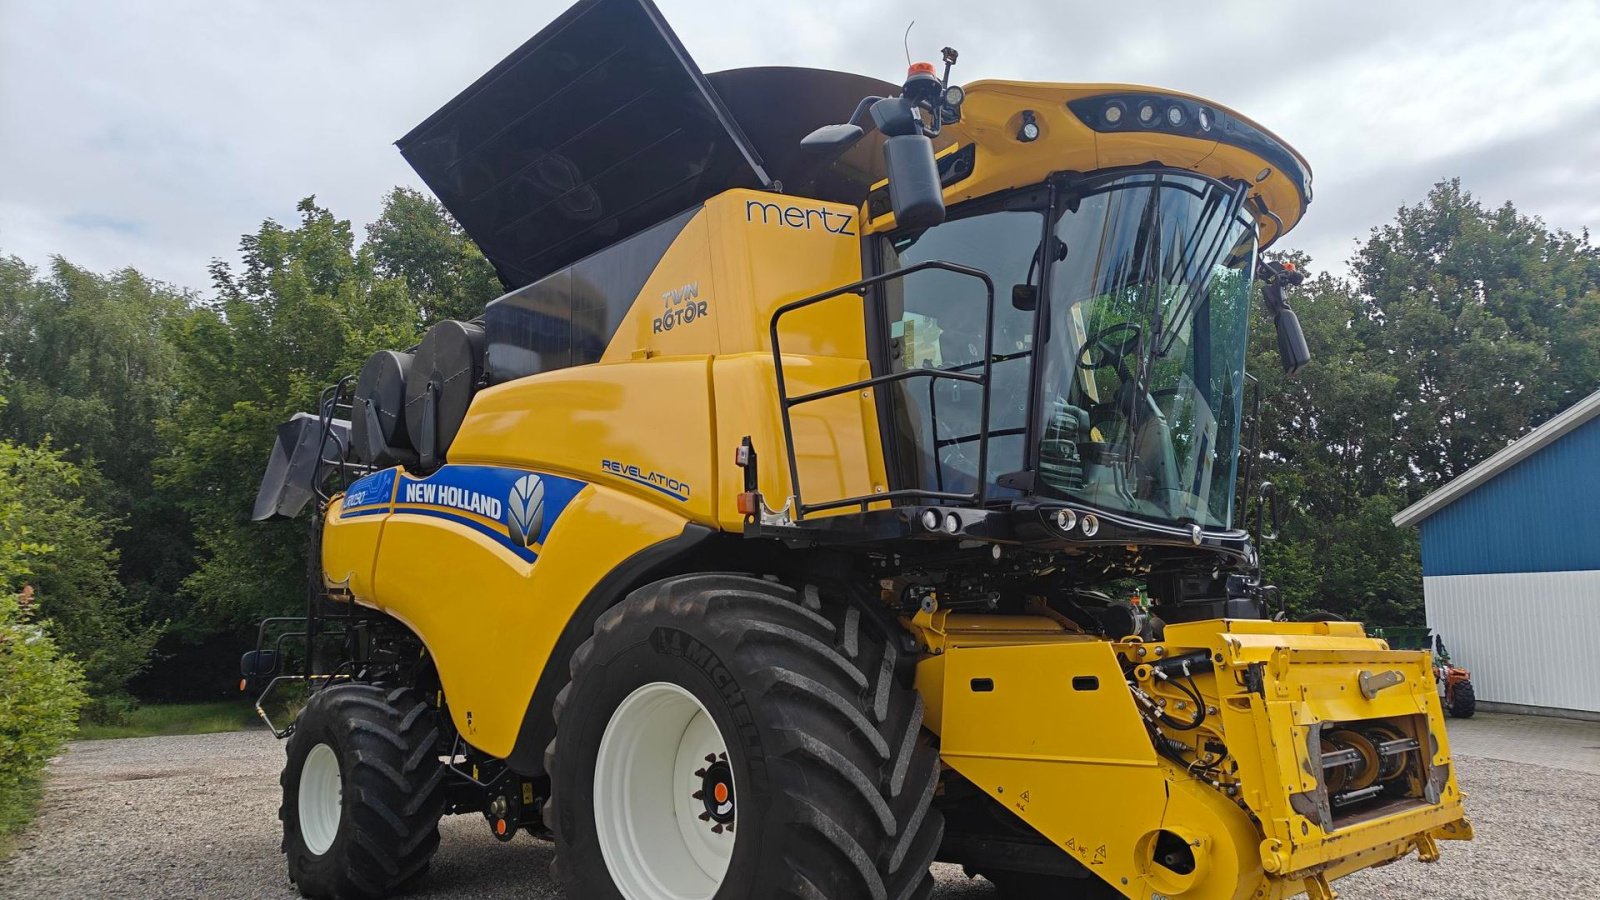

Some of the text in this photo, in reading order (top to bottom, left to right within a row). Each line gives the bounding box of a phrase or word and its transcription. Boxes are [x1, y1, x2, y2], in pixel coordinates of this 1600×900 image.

[746, 200, 855, 236] mertz
[662, 281, 698, 308] TWIN
[653, 301, 708, 334] ROTOR
[602, 459, 690, 496] REVELATION
[406, 484, 502, 520] NEW HOLLAND
[684, 640, 769, 780] MICHELIN
